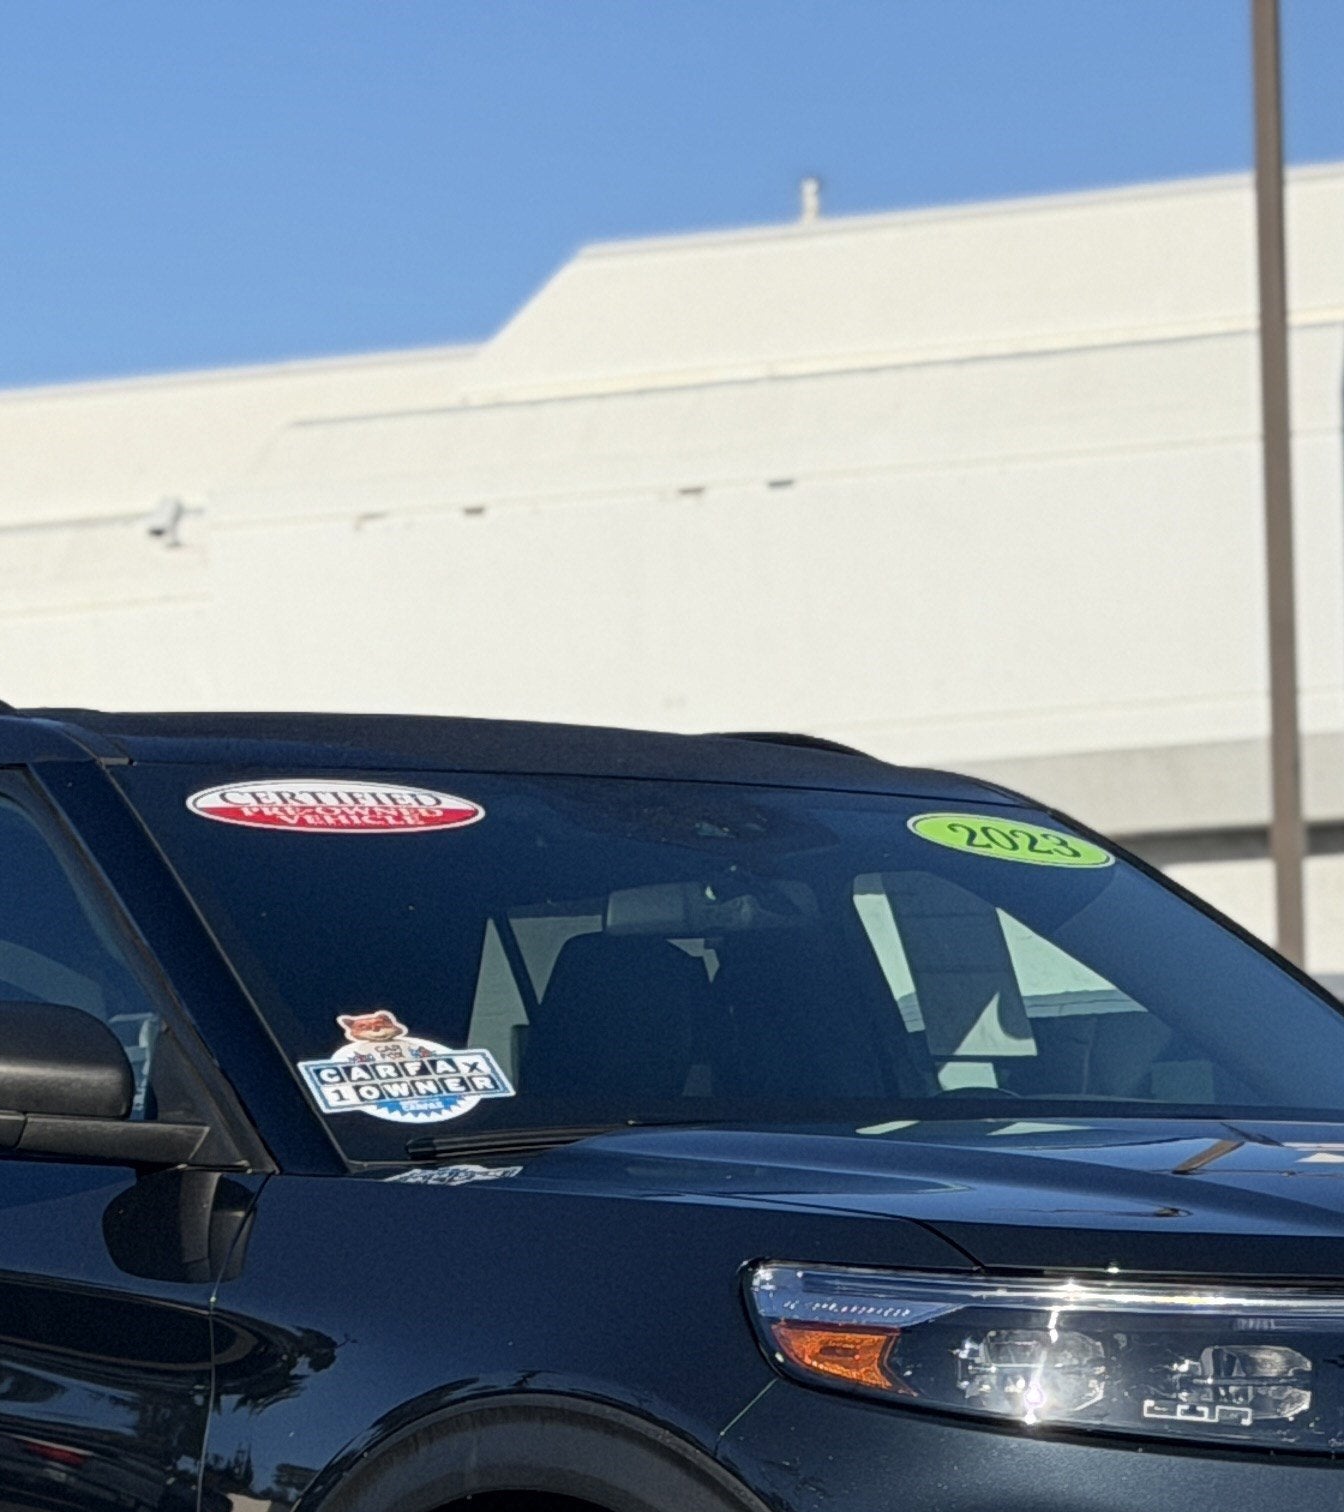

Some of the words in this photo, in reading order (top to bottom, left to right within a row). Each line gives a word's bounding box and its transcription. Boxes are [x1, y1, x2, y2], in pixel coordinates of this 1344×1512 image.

[220, 789, 442, 807] CERTIFIED
[241, 805, 444, 818] PRE-OWNED
[279, 812, 425, 826] VEHICLE
[946, 822, 1082, 859] 2023
[318, 1058, 487, 1084] CARFAX
[331, 1088, 352, 1102] 1
[358, 1075, 499, 1101] OWNER
